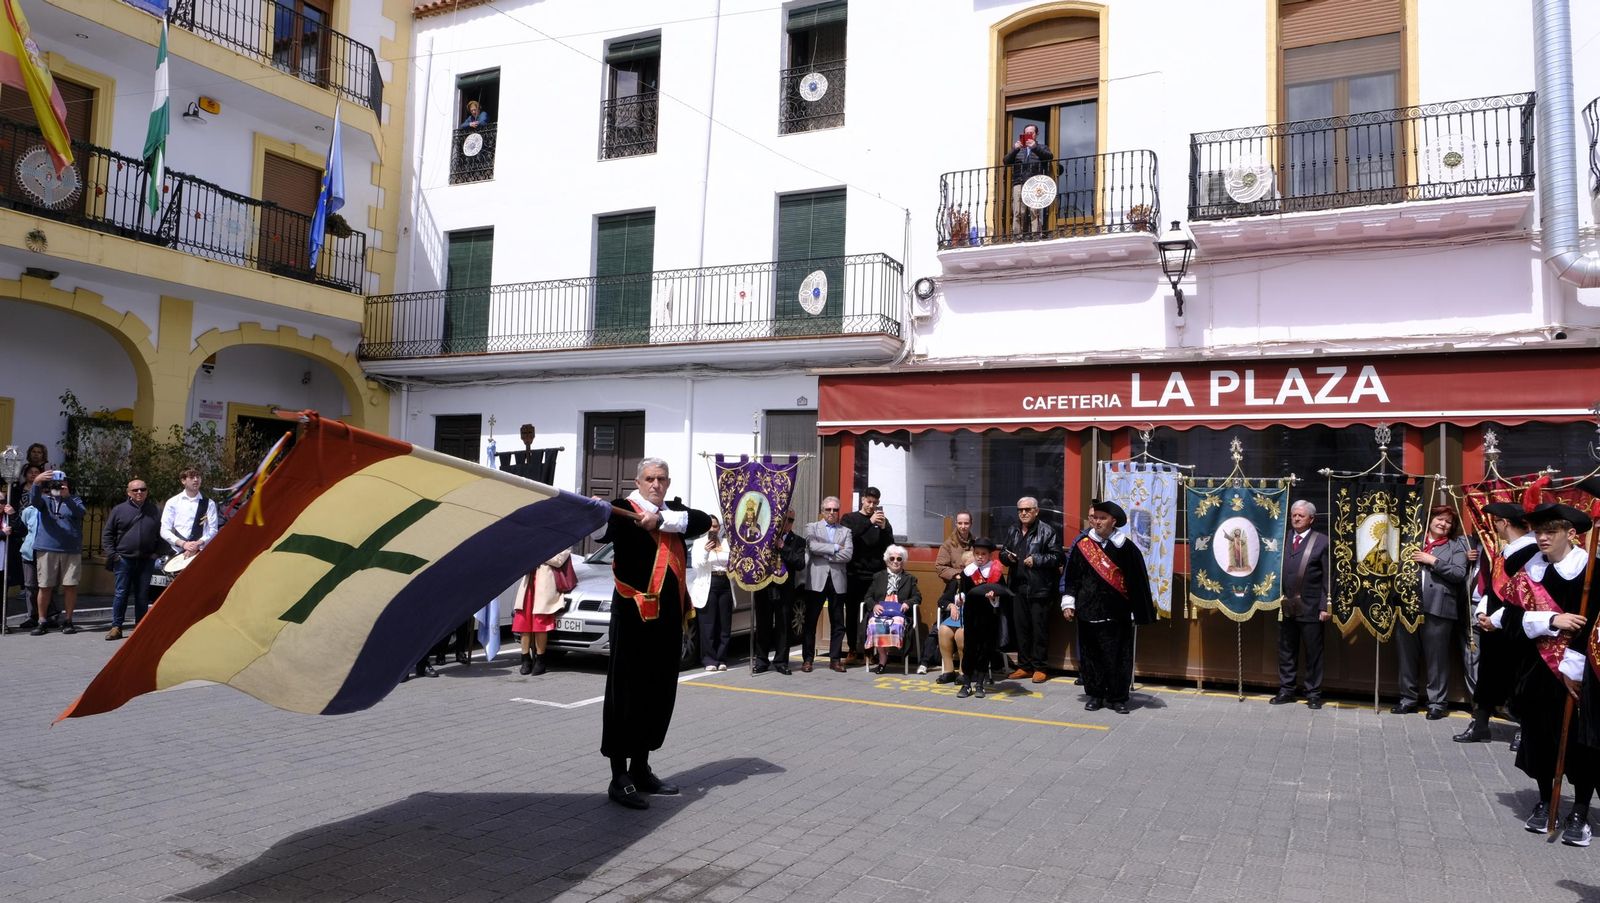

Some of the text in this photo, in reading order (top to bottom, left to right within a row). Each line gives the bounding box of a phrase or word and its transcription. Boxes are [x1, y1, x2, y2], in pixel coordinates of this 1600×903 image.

[1022, 365, 1391, 411] CAFETERIA LA PLAZA
